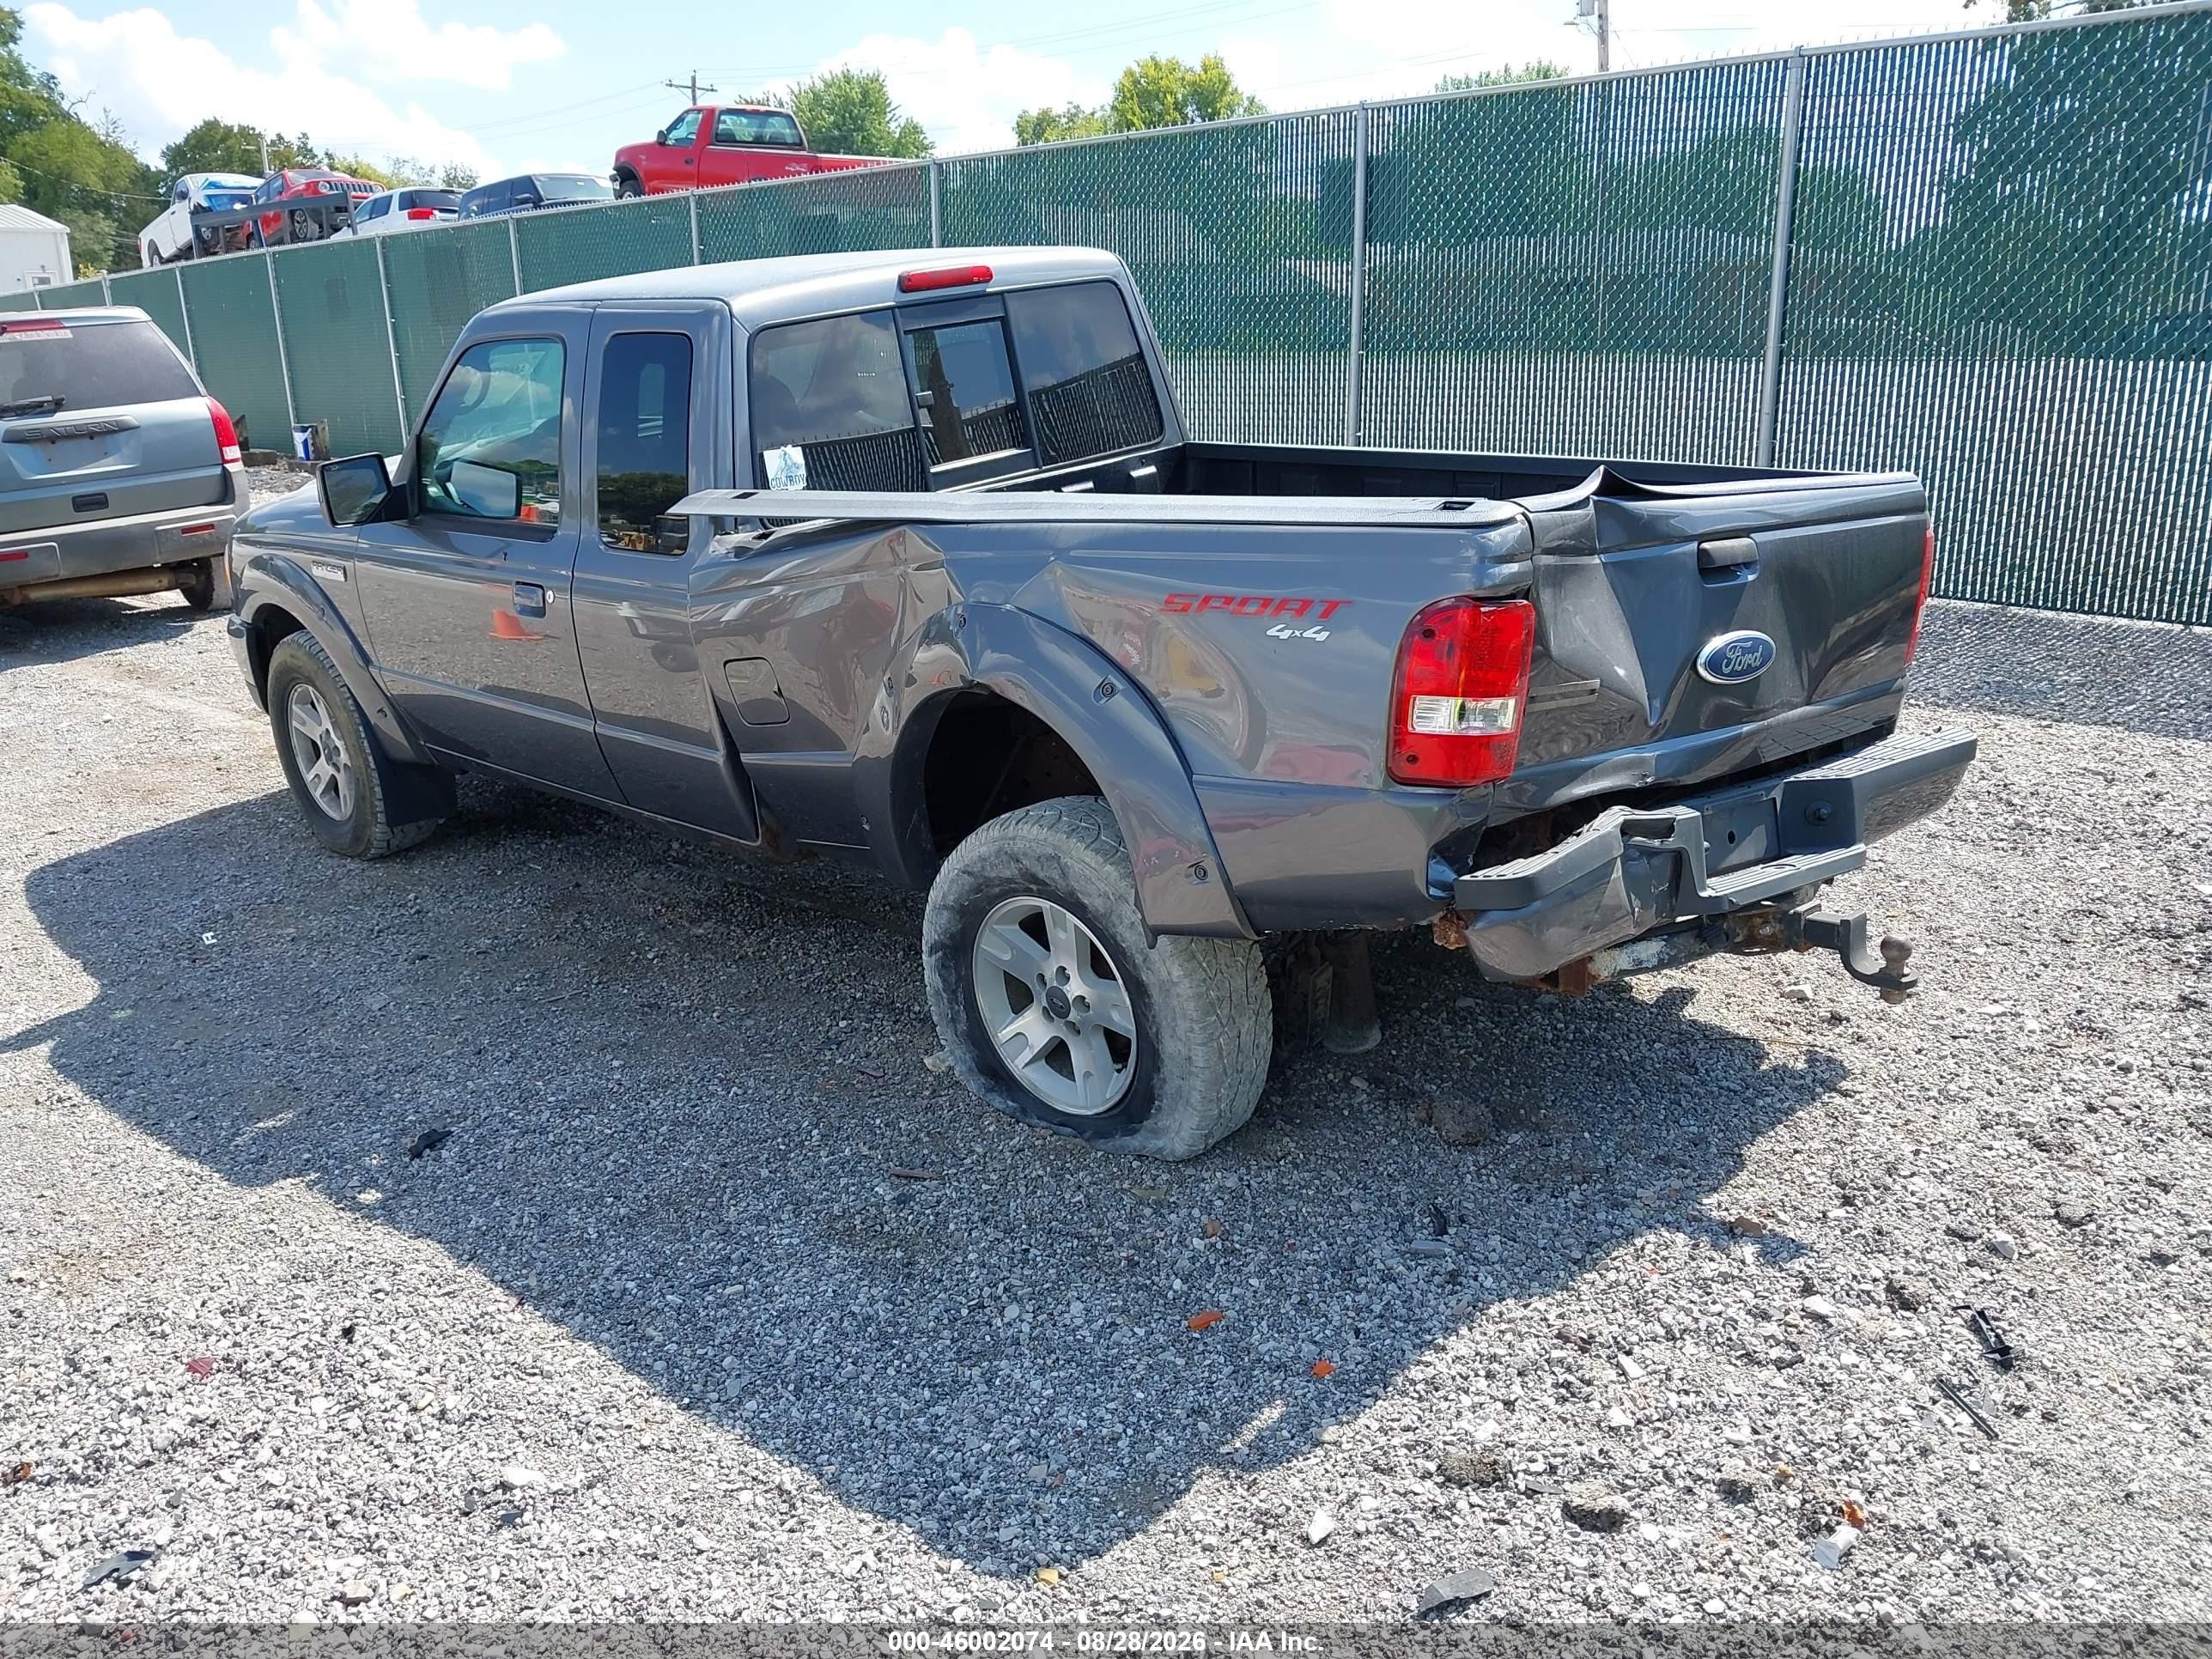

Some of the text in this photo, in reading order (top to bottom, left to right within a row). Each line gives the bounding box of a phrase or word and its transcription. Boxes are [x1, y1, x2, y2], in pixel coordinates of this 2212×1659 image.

[23, 420, 119, 441] SATURN
[770, 473, 805, 489] COWBOY
[1159, 593, 1354, 622] SPORT
[1266, 623, 1330, 642] 4x4
[1722, 641, 1763, 674] Ford
